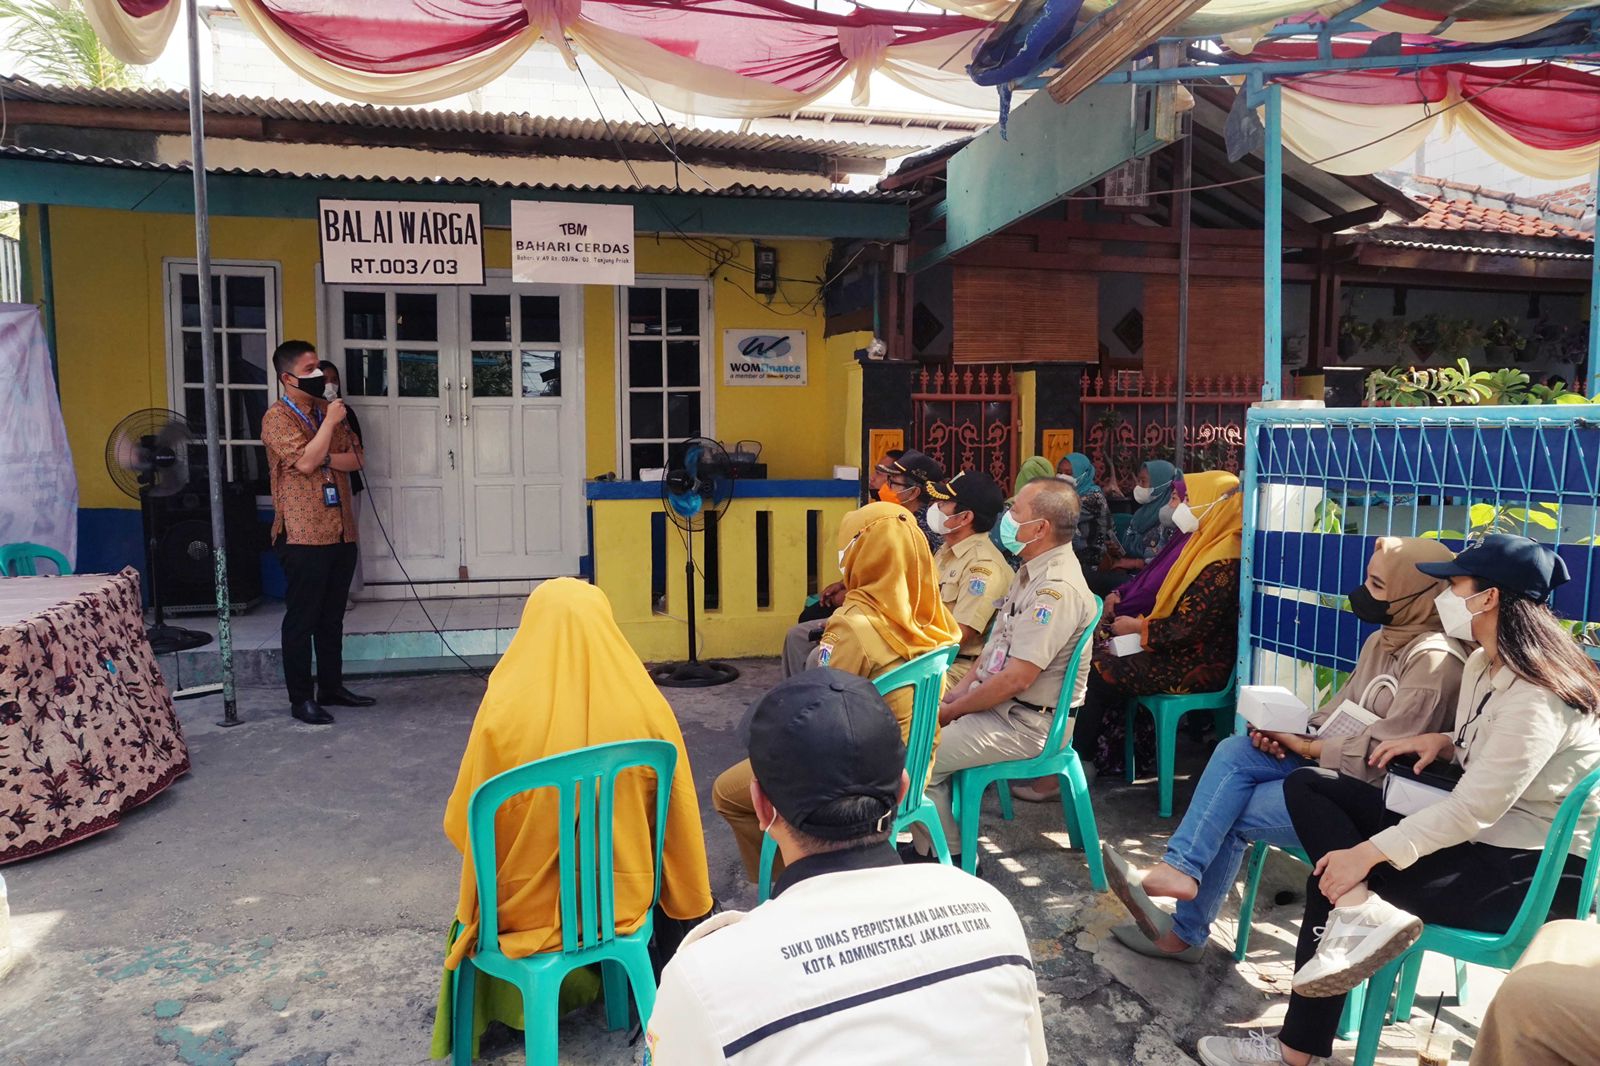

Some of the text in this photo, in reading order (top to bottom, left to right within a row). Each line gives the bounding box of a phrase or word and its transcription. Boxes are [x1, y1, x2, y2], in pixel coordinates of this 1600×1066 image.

[324, 209, 478, 245] BALAI WARGA
[559, 222, 588, 237] TBM
[516, 240, 630, 254] BAHARI CERDAS
[351, 258, 458, 275] RT.003/03
[780, 902, 993, 960] SUKU DINAS PERPUSTAKAAN DAN KEARSIPAN
[802, 917, 992, 976] KOTA ADMINISTRASI JAKARTA UTARA
